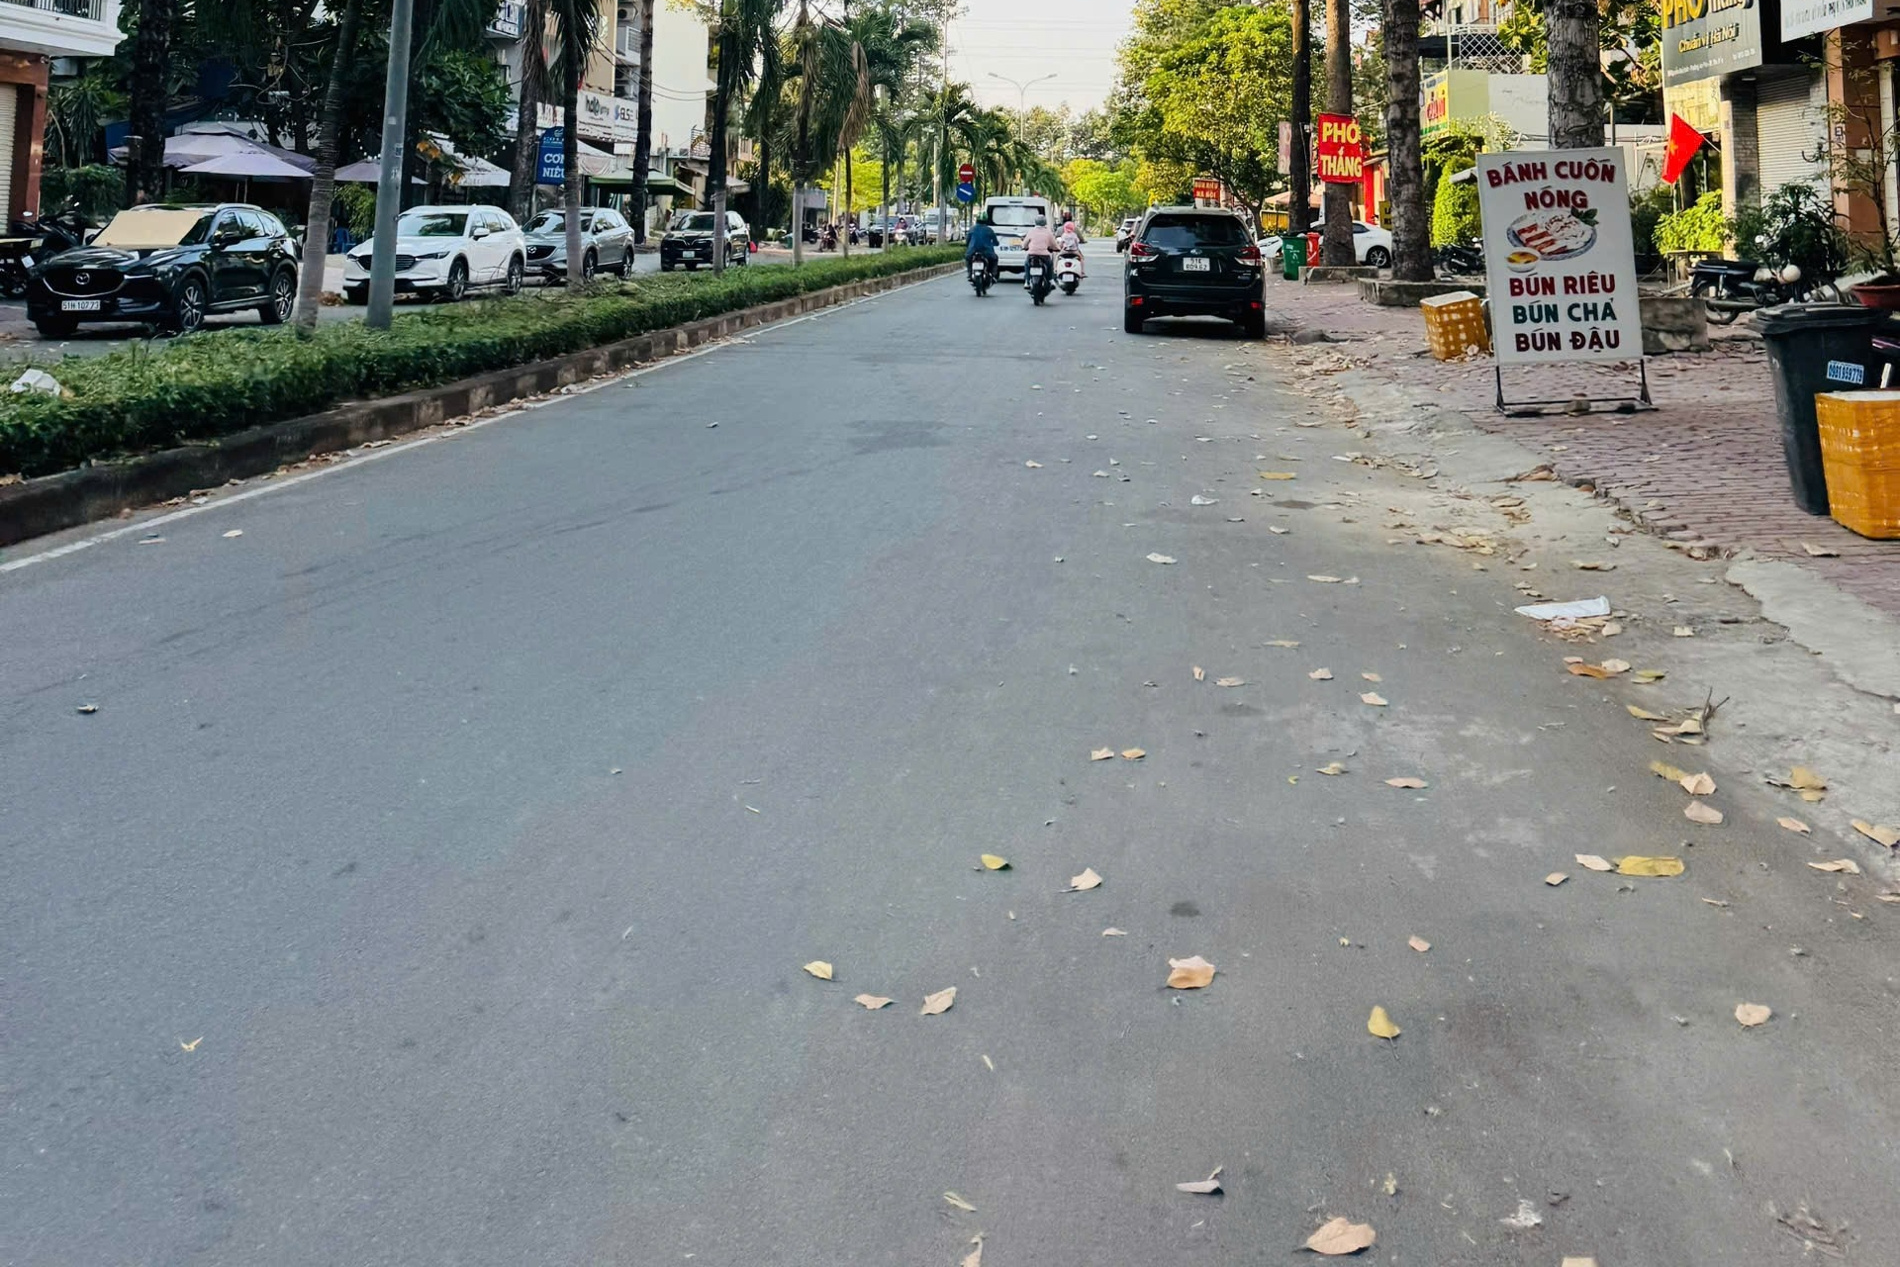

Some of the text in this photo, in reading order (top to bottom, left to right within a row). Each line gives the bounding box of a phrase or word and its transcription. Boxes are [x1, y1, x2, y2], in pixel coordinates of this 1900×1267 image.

[1322, 118, 1361, 144] PHỞ
[1486, 161, 1547, 188] BÁNH
[1524, 185, 1588, 210] NÓNG
[1509, 271, 1616, 297] BÚN RIÊU
[1512, 297, 1617, 324] BÚN CHẢ
[1515, 326, 1620, 353] BÚN ĐẬU
